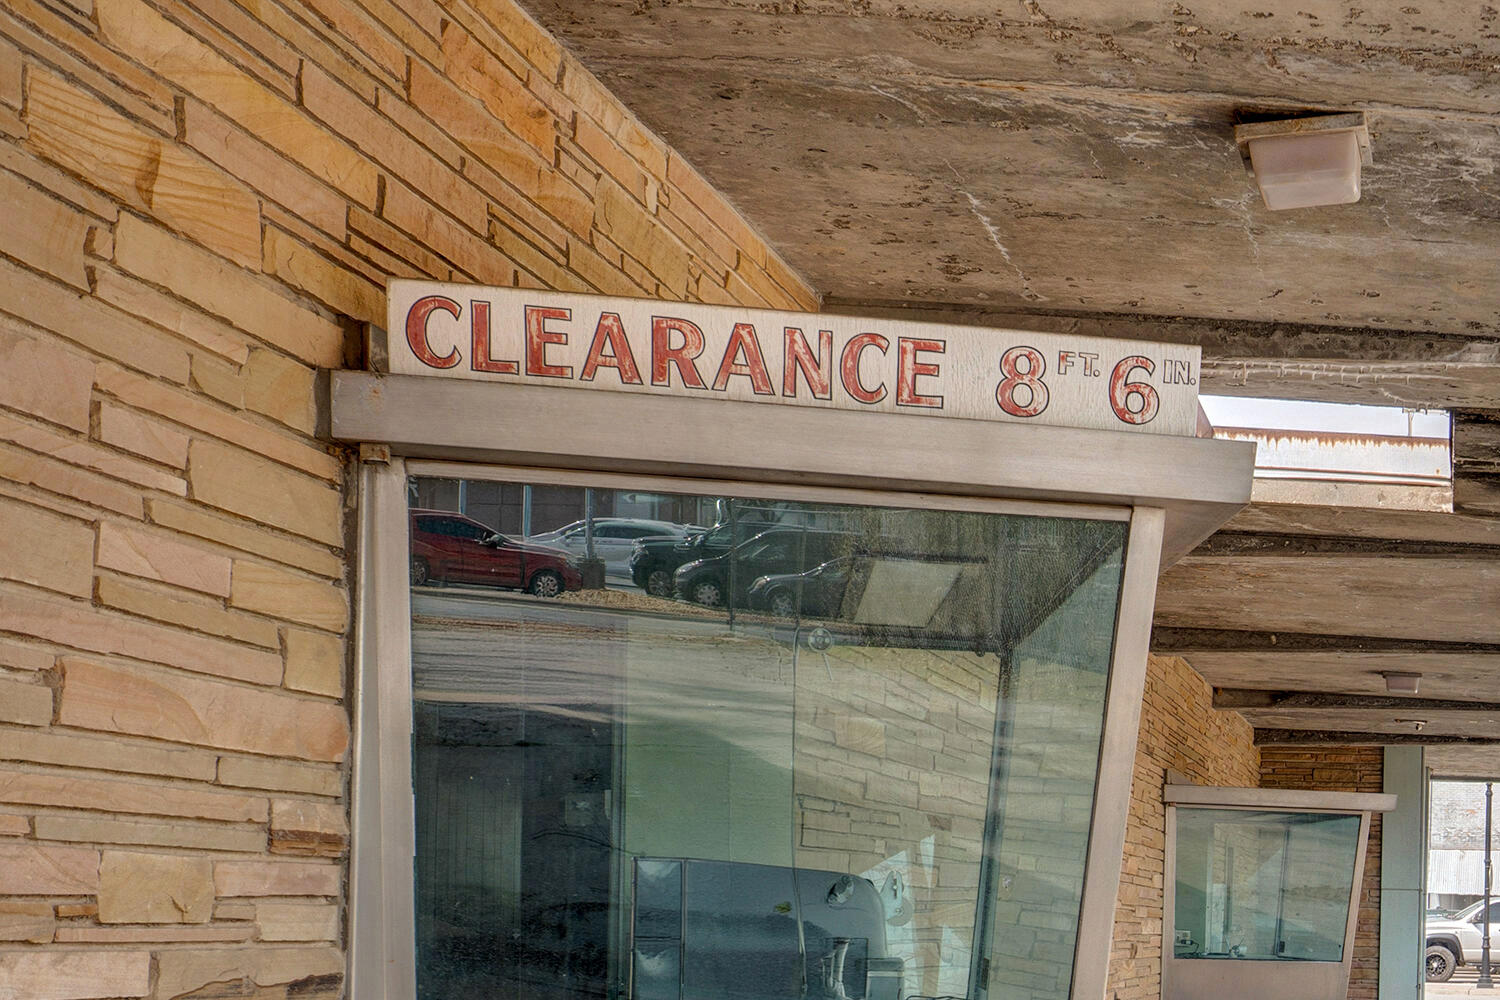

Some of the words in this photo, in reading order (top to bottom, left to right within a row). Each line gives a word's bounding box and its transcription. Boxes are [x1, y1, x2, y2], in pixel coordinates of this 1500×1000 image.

[405, 295, 946, 409] CLEARANCE
[996, 346, 1049, 417] 8
[1058, 351, 1100, 377] FT.
[1109, 355, 1160, 425] 6
[1163, 359, 1197, 386] IN.
